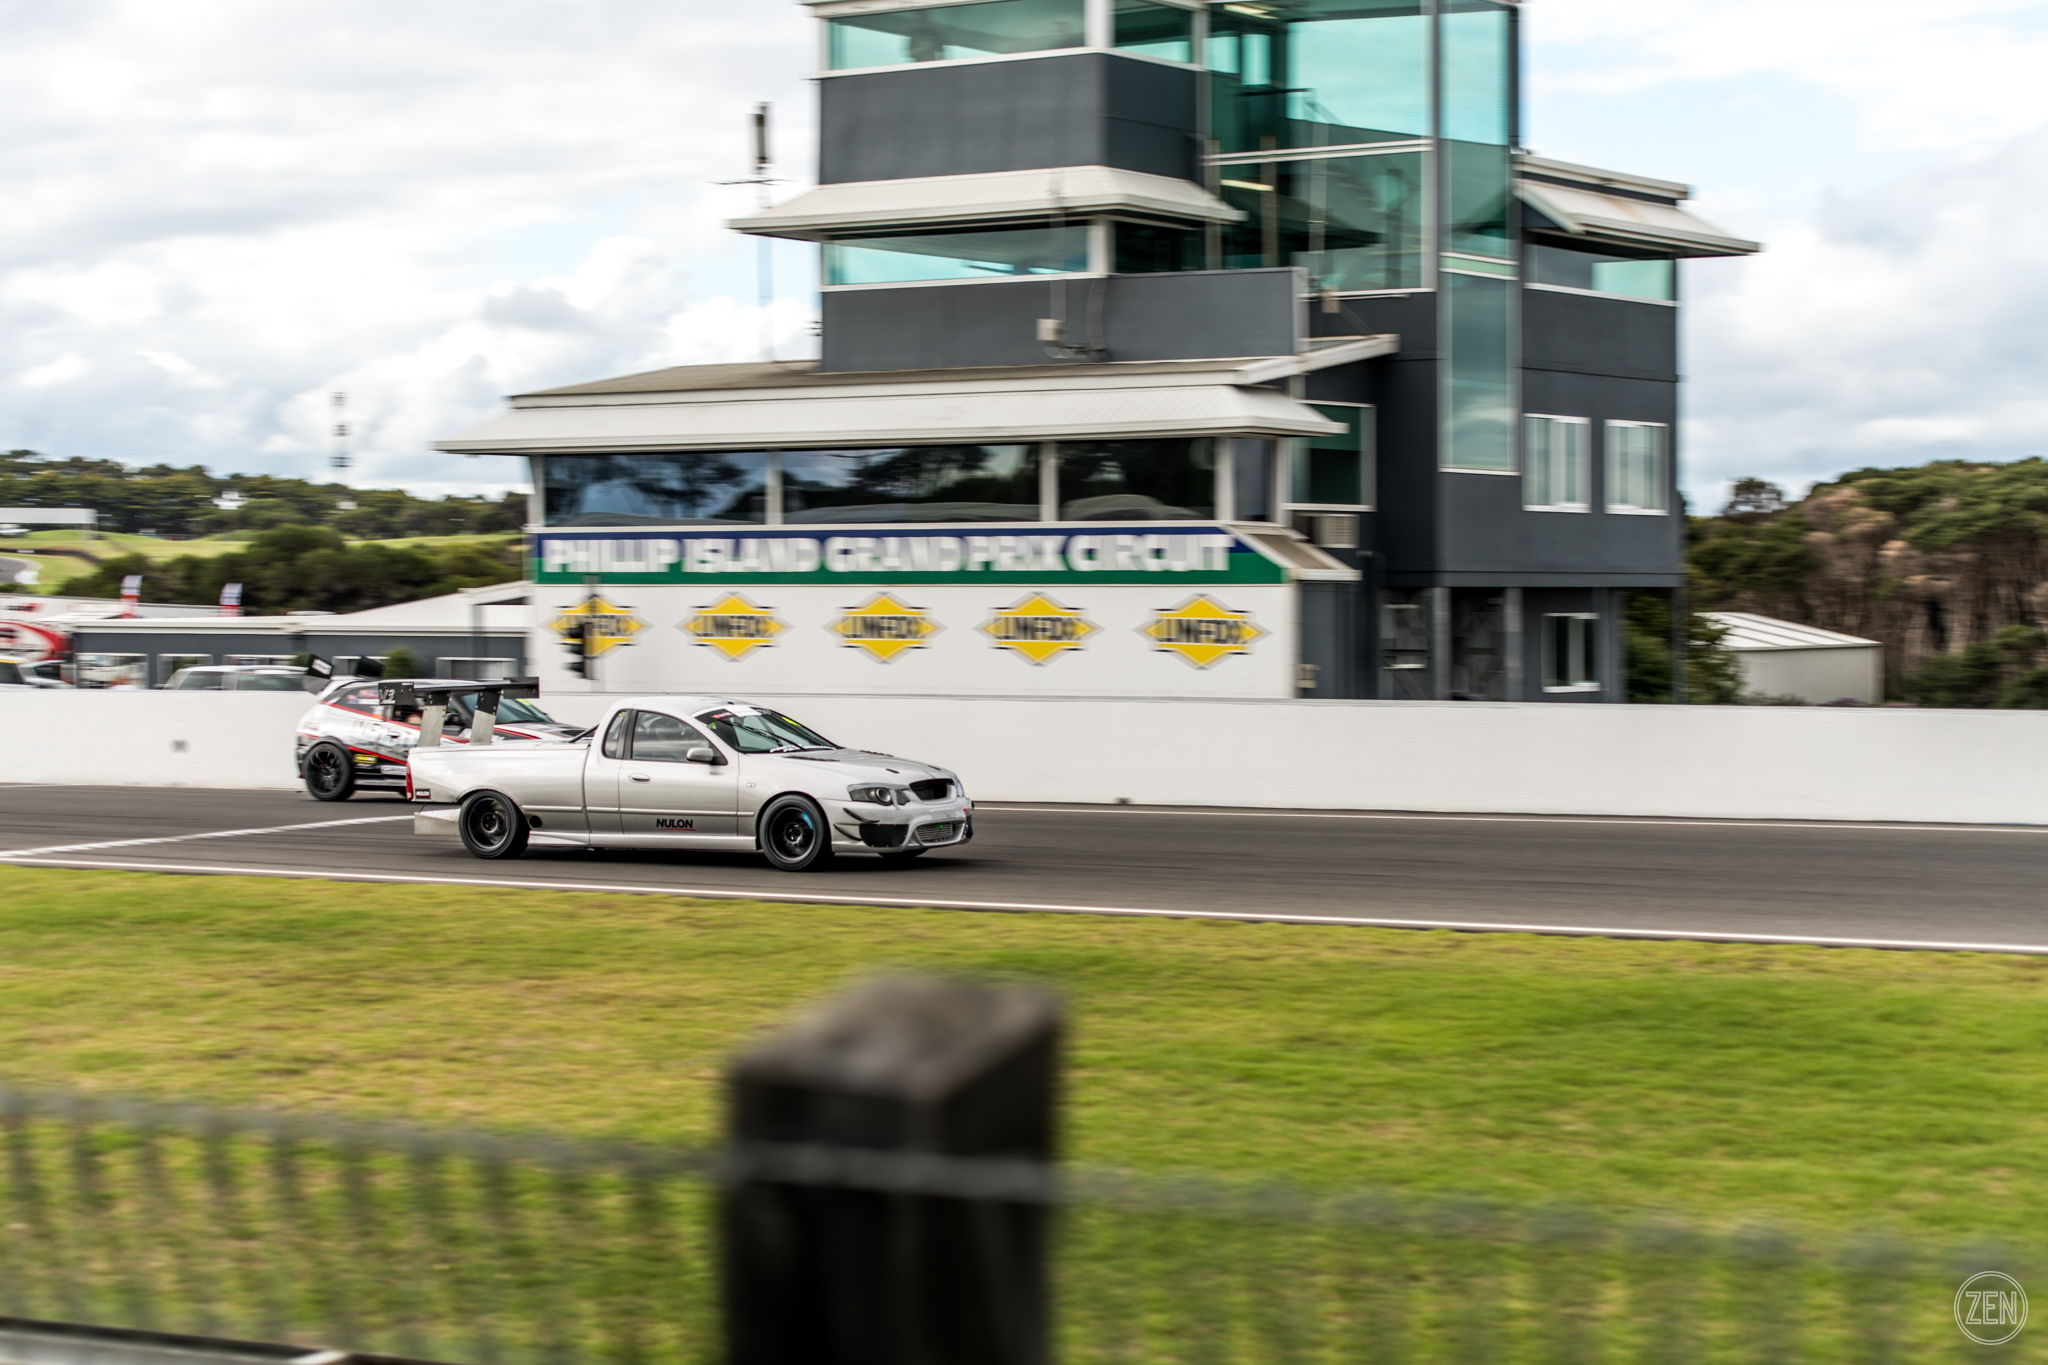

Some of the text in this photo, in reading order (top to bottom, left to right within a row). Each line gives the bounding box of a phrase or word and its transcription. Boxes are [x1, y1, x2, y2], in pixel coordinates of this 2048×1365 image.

[542, 534, 1235, 573] PHILLIP ISLAND GRAND PRIX CIRCUIT
[693, 615, 769, 637] LINFOX
[843, 616, 923, 639] LINFOX
[994, 617, 1079, 640] LINFOX
[1155, 619, 1244, 644] LINFOX
[656, 818, 694, 829] NULON
